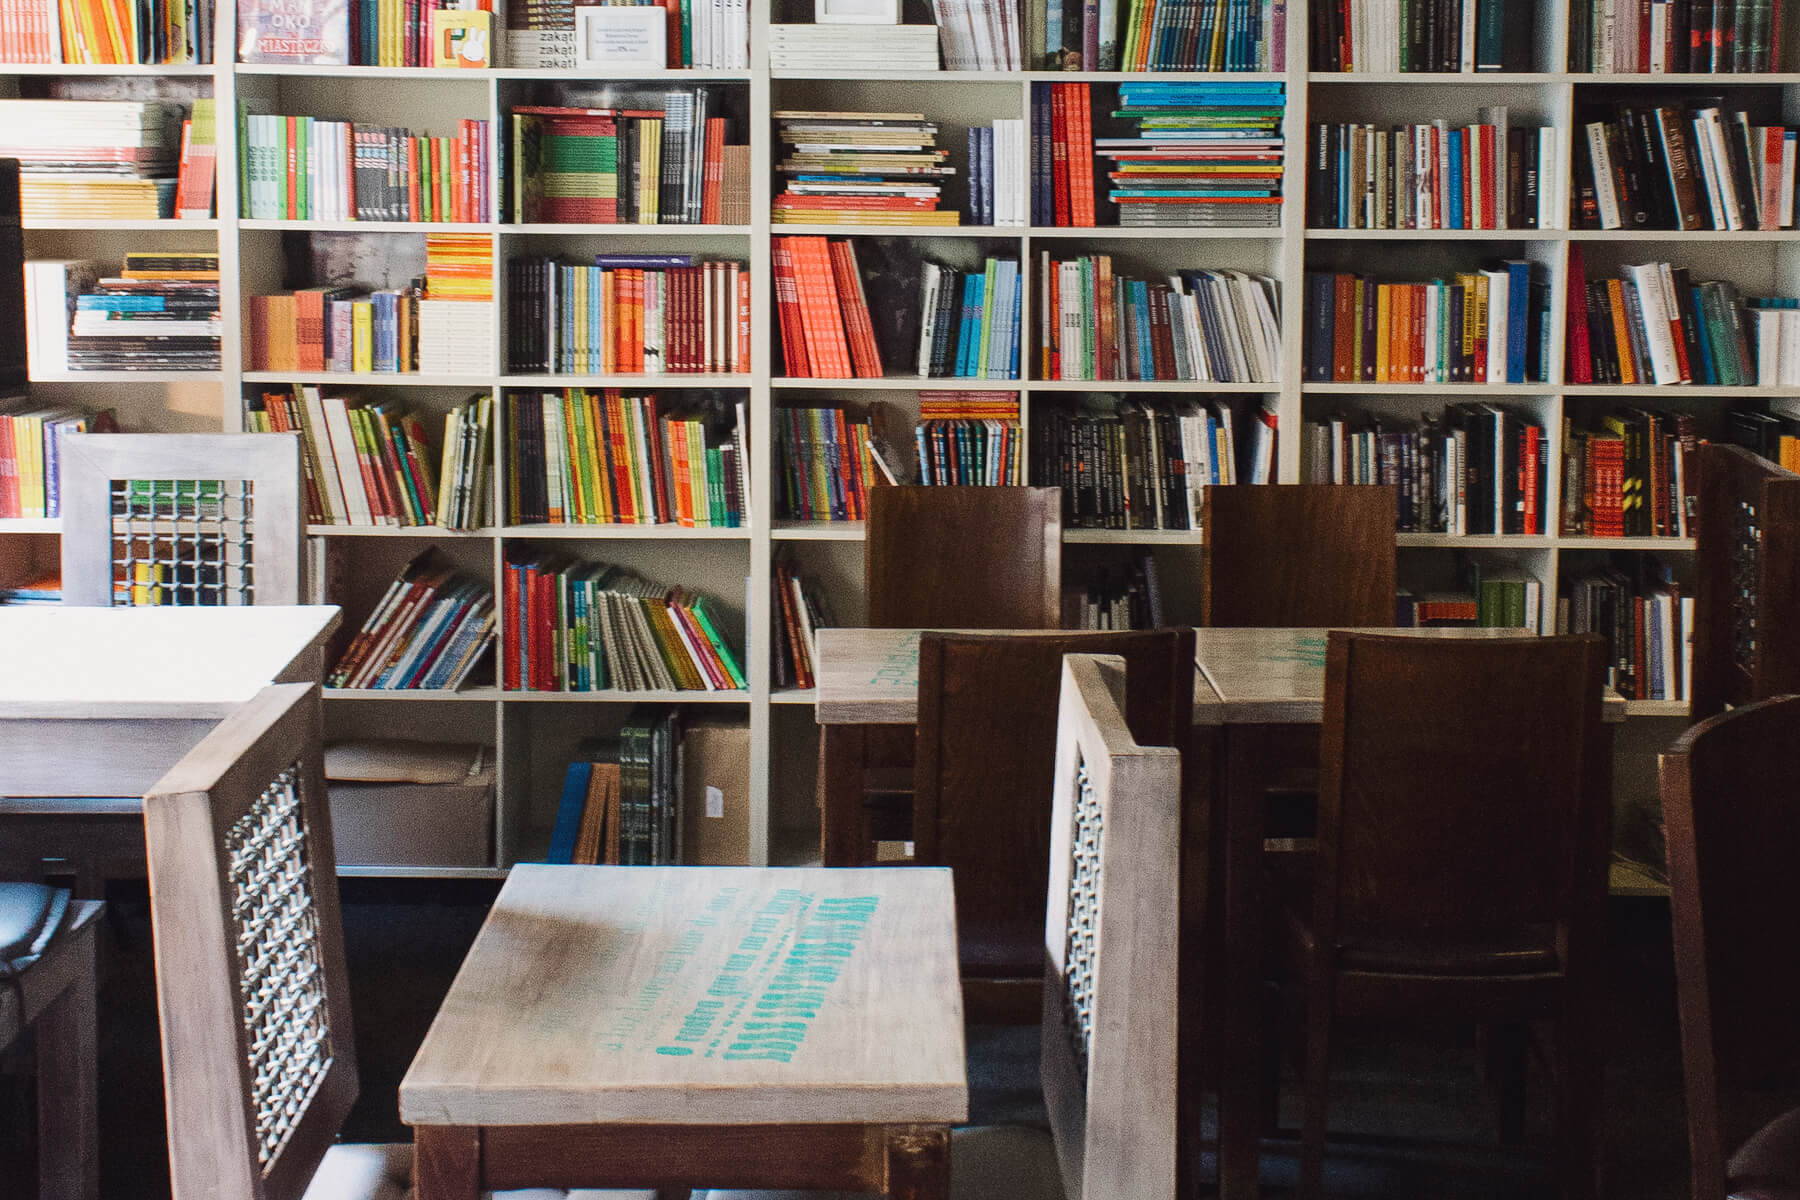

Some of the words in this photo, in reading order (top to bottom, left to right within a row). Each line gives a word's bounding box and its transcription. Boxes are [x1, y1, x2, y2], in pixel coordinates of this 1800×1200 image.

[271, 14, 312, 29] OKO
[540, 32, 577, 44] zakąt
[540, 46, 577, 58] zakąt
[540, 59, 577, 69] zakąt
